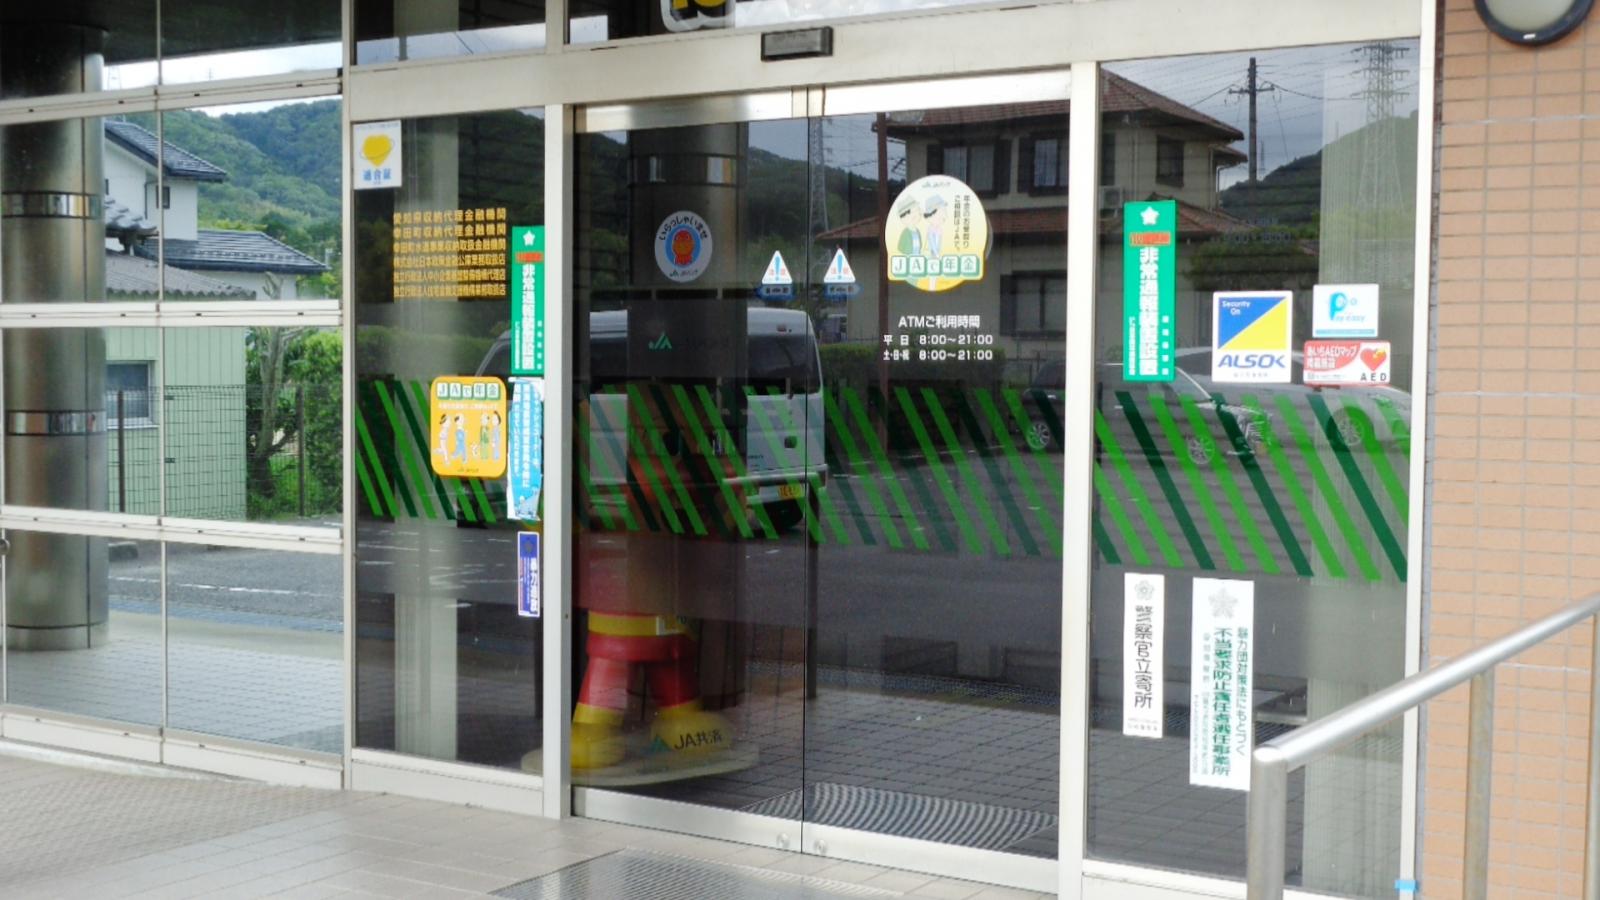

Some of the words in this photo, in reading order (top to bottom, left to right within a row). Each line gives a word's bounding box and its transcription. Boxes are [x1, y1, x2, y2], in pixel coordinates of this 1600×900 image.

[659, 216, 708, 240] いらっしゃいませ
[1222, 301, 1251, 309] Security
[898, 315, 980, 329] ATMご利用時間
[1307, 344, 1357, 358] あいちAEDマップ
[1218, 354, 1285, 369] ALSOK
[1134, 605, 1153, 709] 警察官立寄所
[674, 729, 723, 750] JA共済
